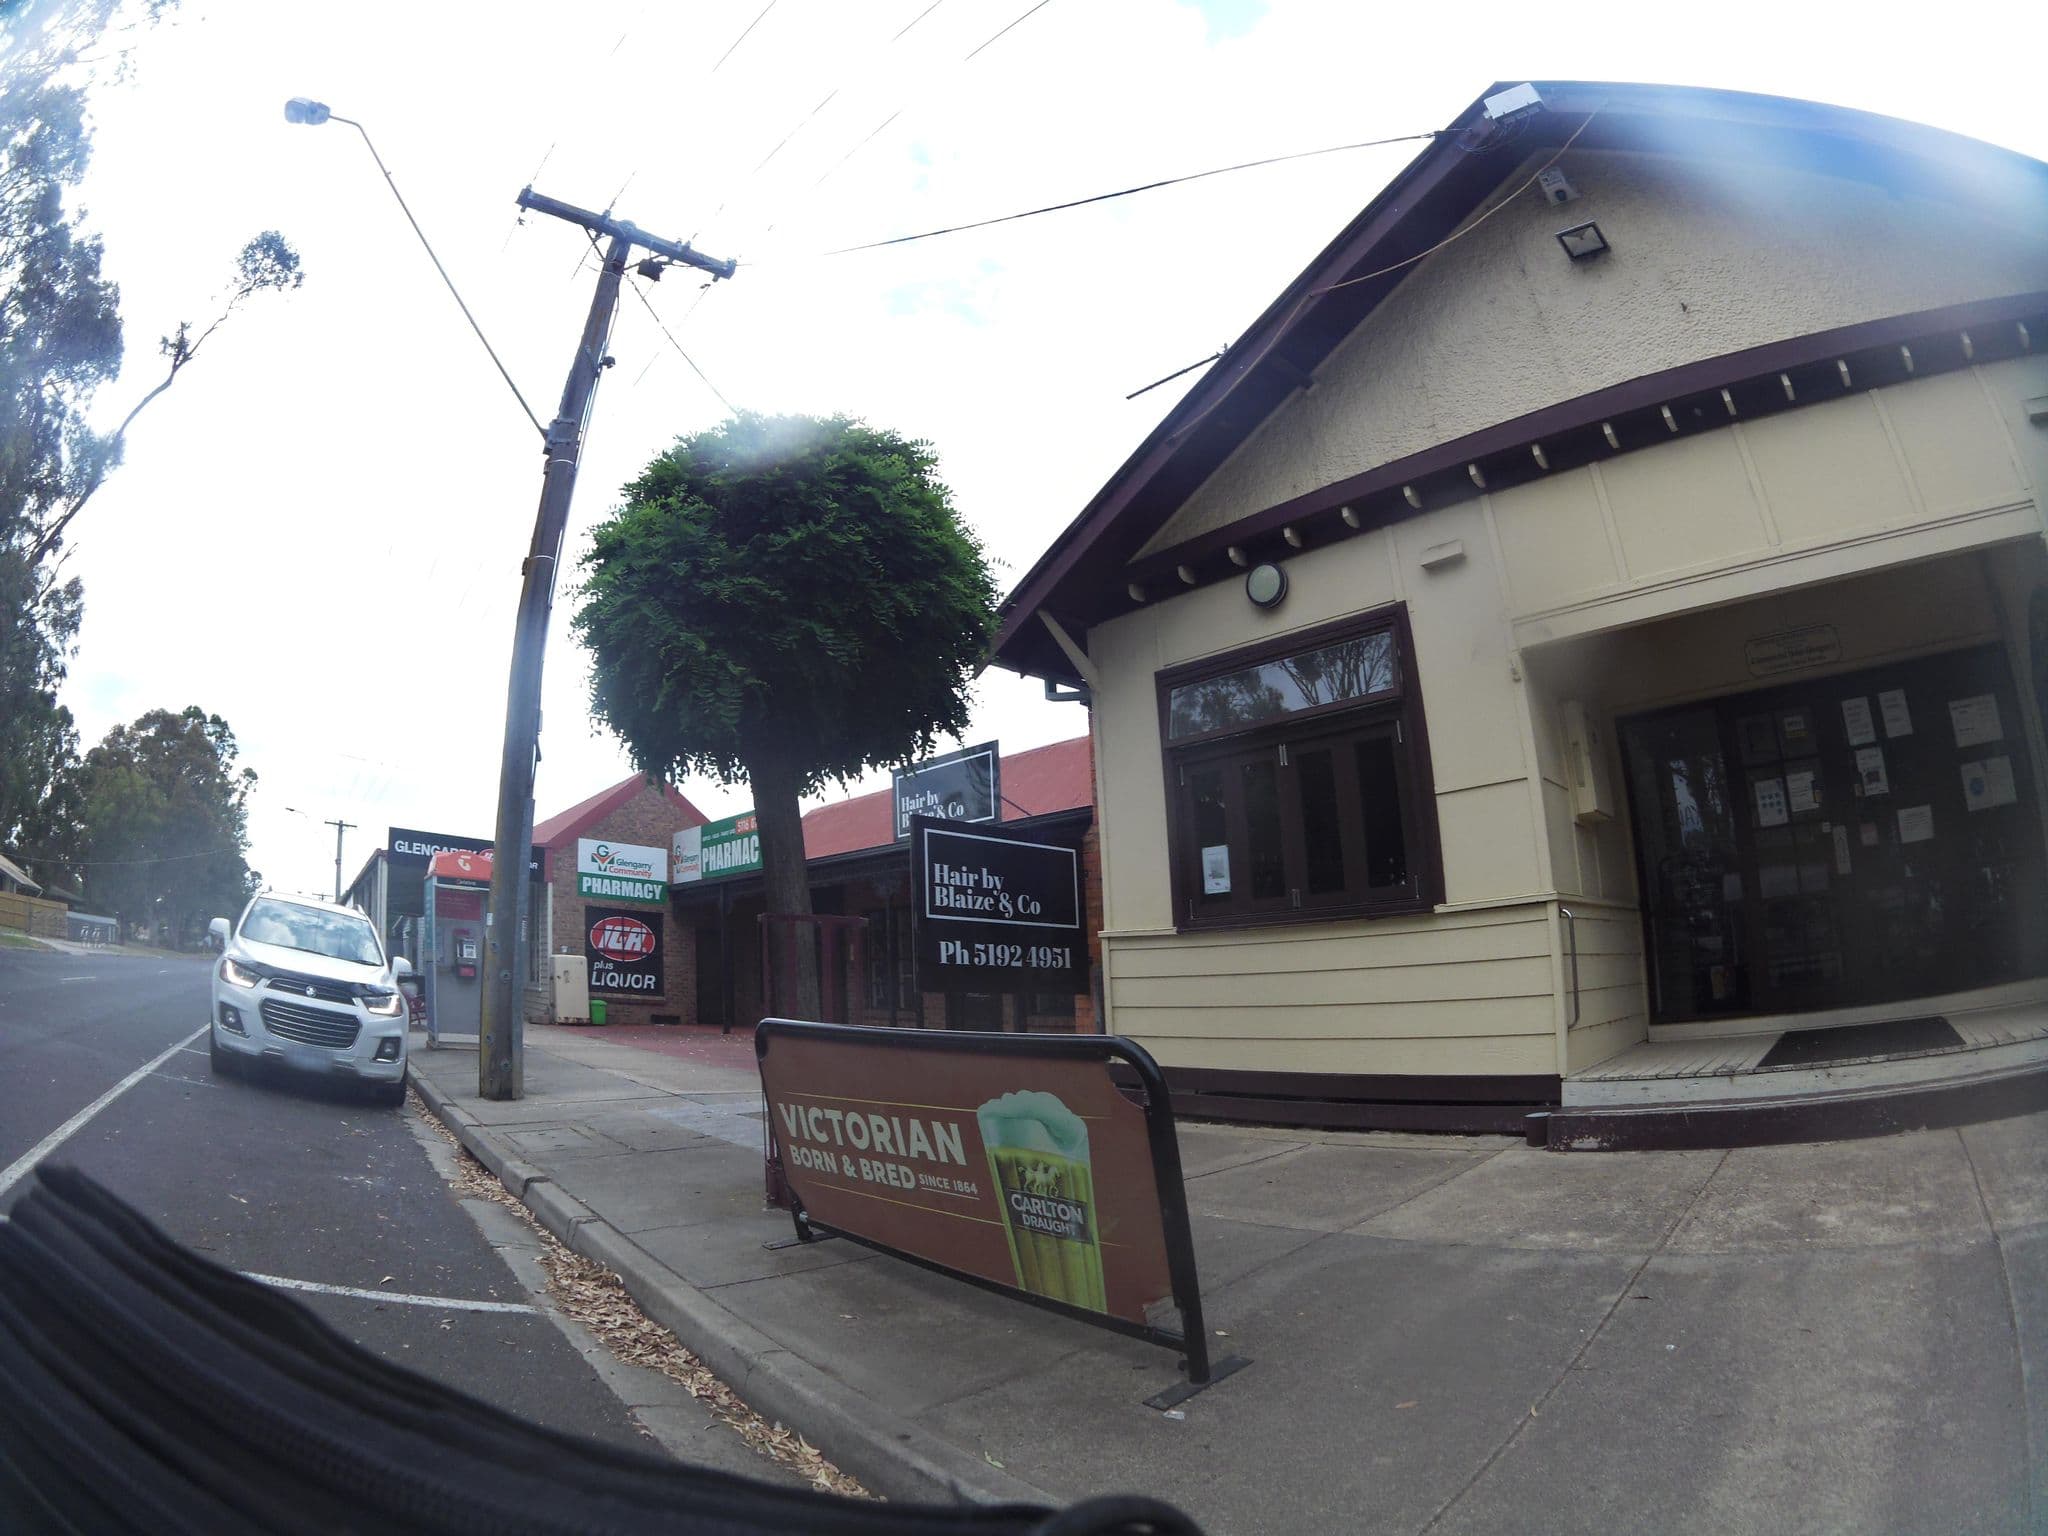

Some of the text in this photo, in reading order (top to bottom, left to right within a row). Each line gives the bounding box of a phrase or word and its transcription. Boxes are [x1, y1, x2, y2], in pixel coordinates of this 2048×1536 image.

[901, 794, 926, 812] Hair
[948, 801, 964, 818] Co
[616, 858, 653, 871] Glengarry
[702, 834, 760, 873] PHARMAC
[609, 866, 653, 879] Community
[934, 863, 1004, 896] Hair by
[582, 876, 663, 900] PHARMACY
[934, 886, 1041, 918] Blaize & Co
[598, 925, 647, 952] IGA
[594, 961, 614, 970] plus
[939, 940, 1072, 969] Ph 5192 4951
[591, 971, 657, 990] LIQUOR
[778, 1102, 968, 1166] VICTORIAN
[789, 1144, 978, 1195] BORN & BRED SINCE 1864
[1011, 1193, 1084, 1225] CARLTON
